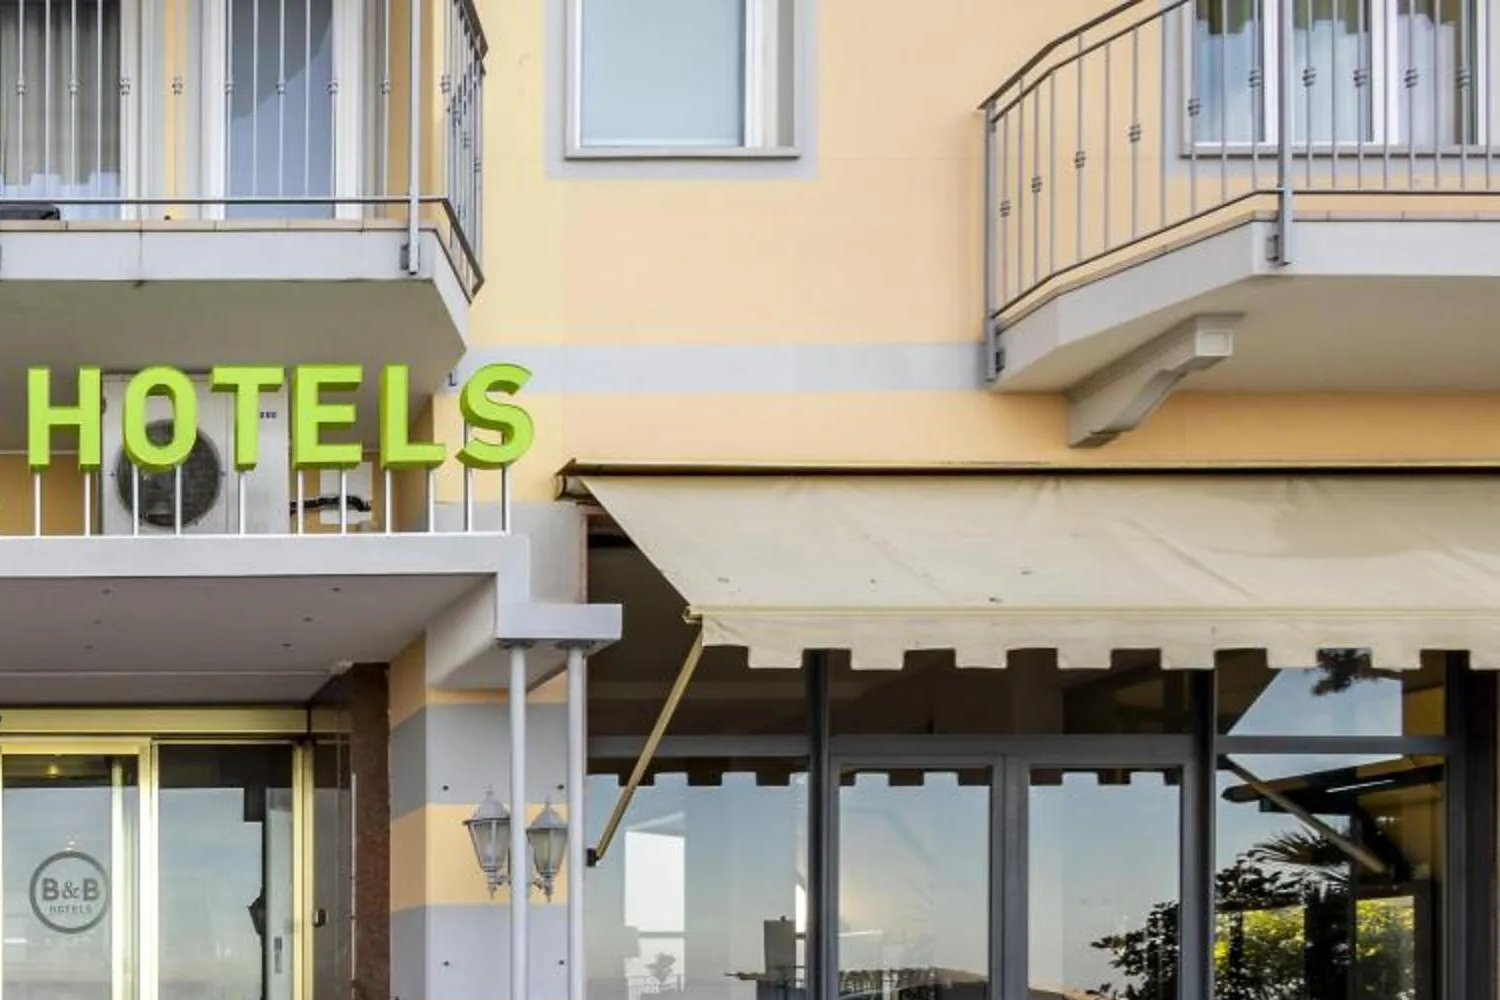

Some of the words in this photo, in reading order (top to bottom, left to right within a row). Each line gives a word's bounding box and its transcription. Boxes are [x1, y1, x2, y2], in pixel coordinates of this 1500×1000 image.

[27, 363, 535, 472] HOTELS
[42, 877, 100, 901] B&B
[49, 903, 93, 914] HOTELS
